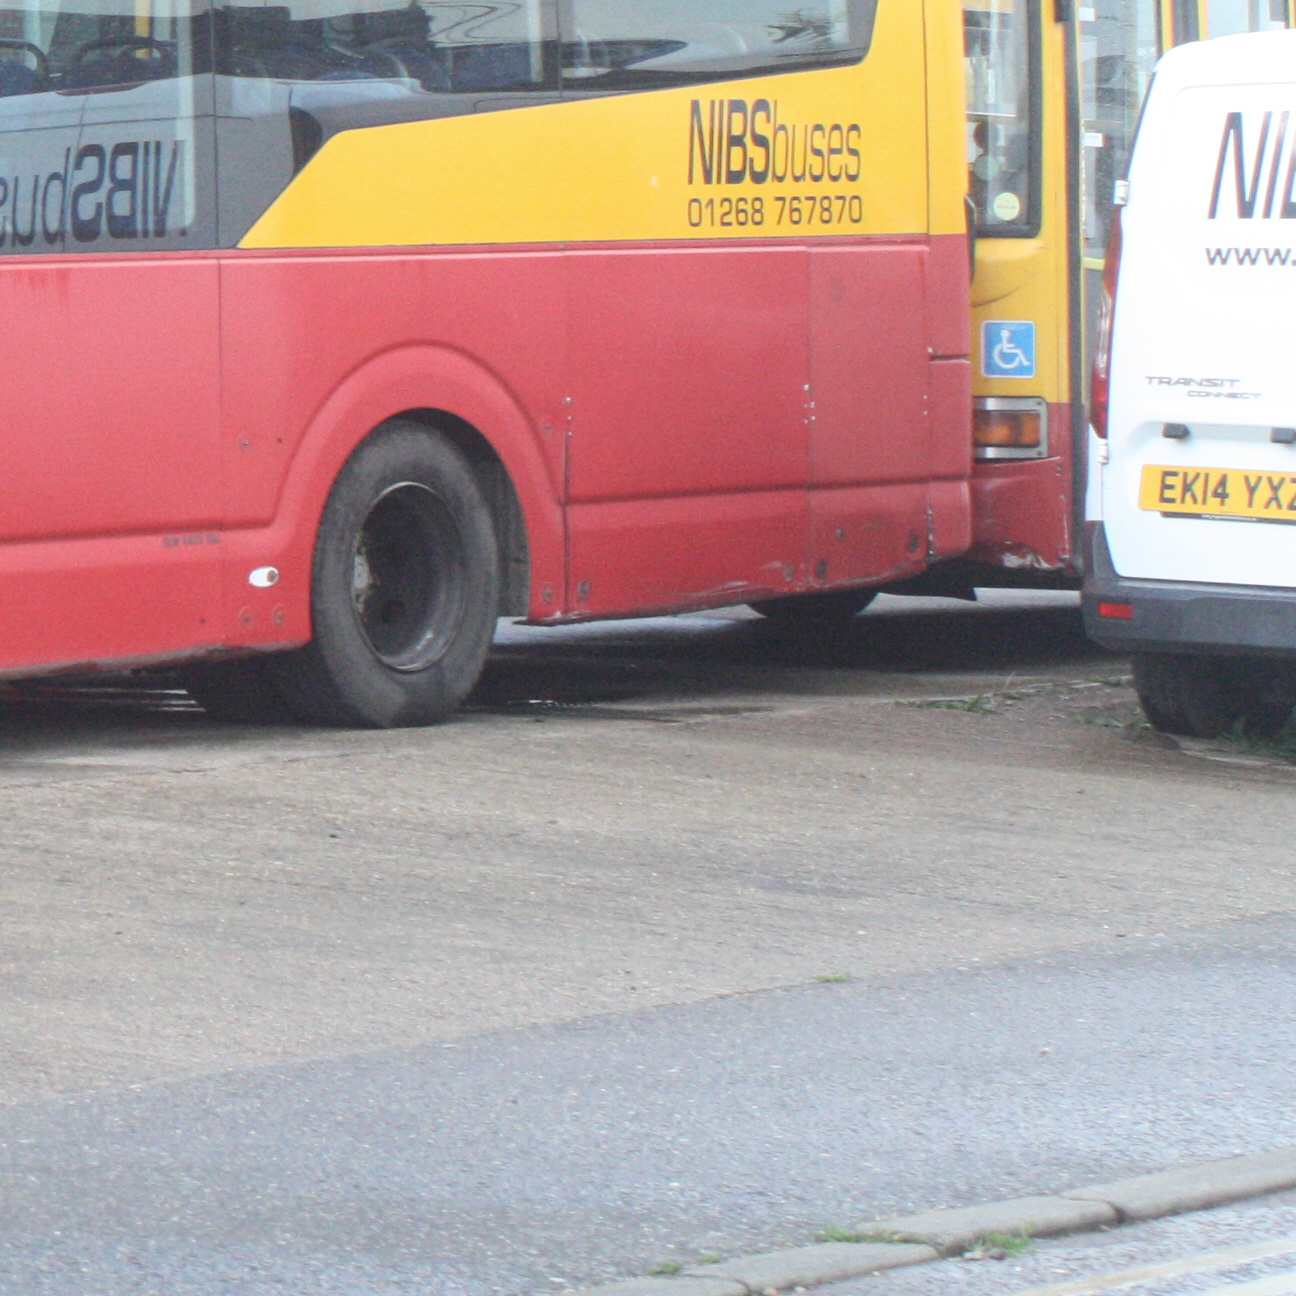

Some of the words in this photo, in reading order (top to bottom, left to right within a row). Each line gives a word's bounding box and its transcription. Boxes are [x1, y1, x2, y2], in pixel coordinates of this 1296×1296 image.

[688, 98, 861, 185] NIBSbuses
[688, 197, 764, 227] 01268
[774, 195, 862, 225] 767870
[1145, 376, 1240, 388] TRANSIT
[1187, 390, 1261, 399] CONNECT
[1158, 470, 1229, 507] EK14
